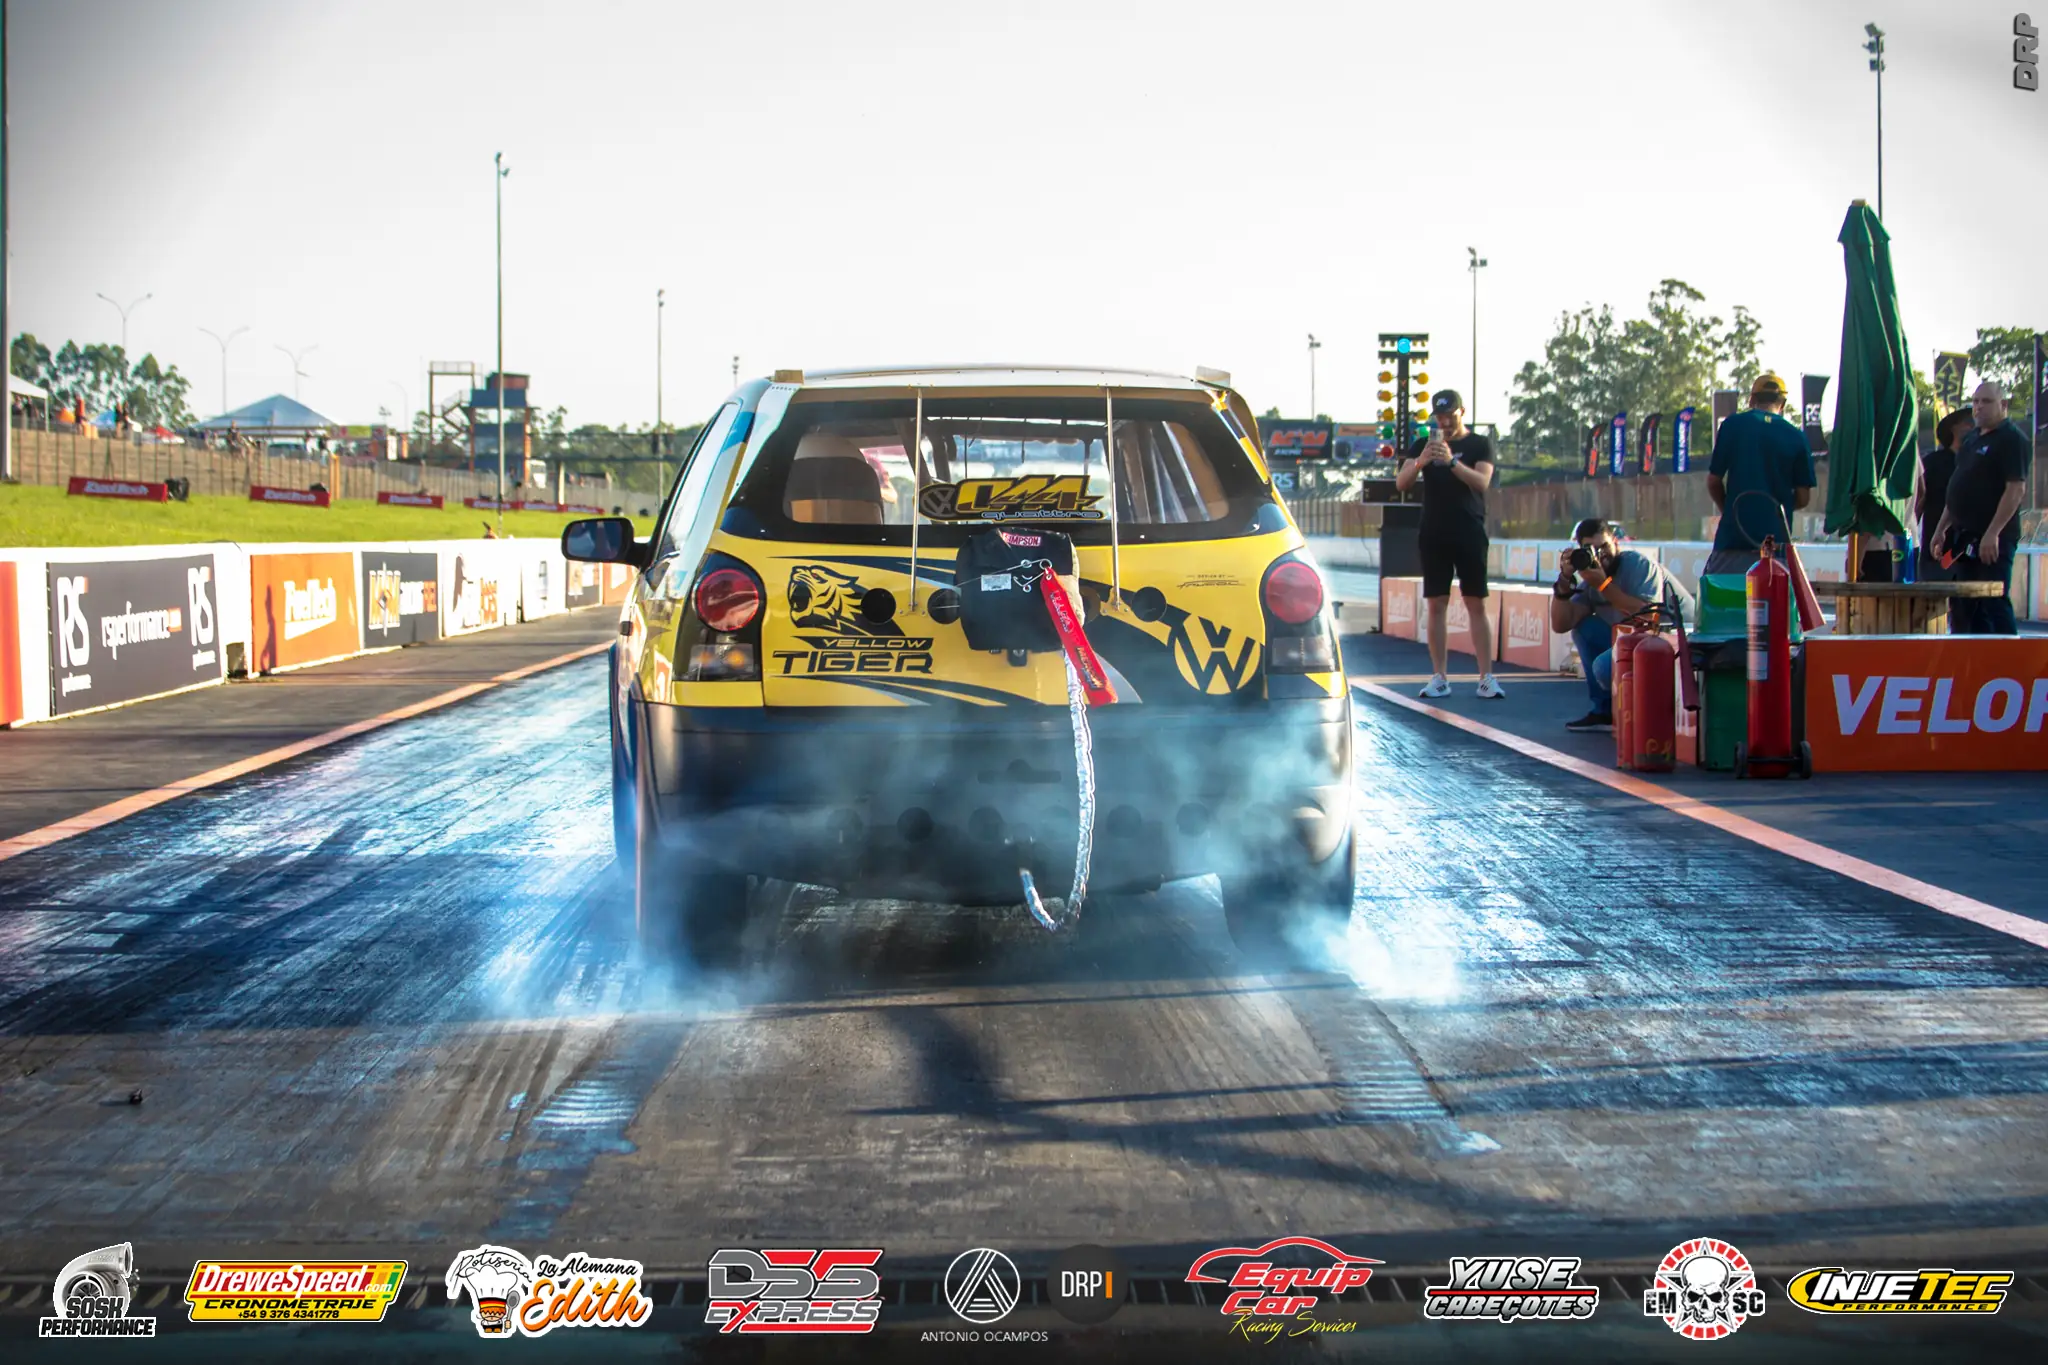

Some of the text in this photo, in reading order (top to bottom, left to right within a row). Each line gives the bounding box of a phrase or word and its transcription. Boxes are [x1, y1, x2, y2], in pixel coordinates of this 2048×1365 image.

[57, 576, 90, 668] RS
[187, 566, 214, 646] RS
[1508, 606, 1544, 642] FuelTech
[822, 638, 927, 649] YELLOW
[772, 650, 934, 675] TIGER
